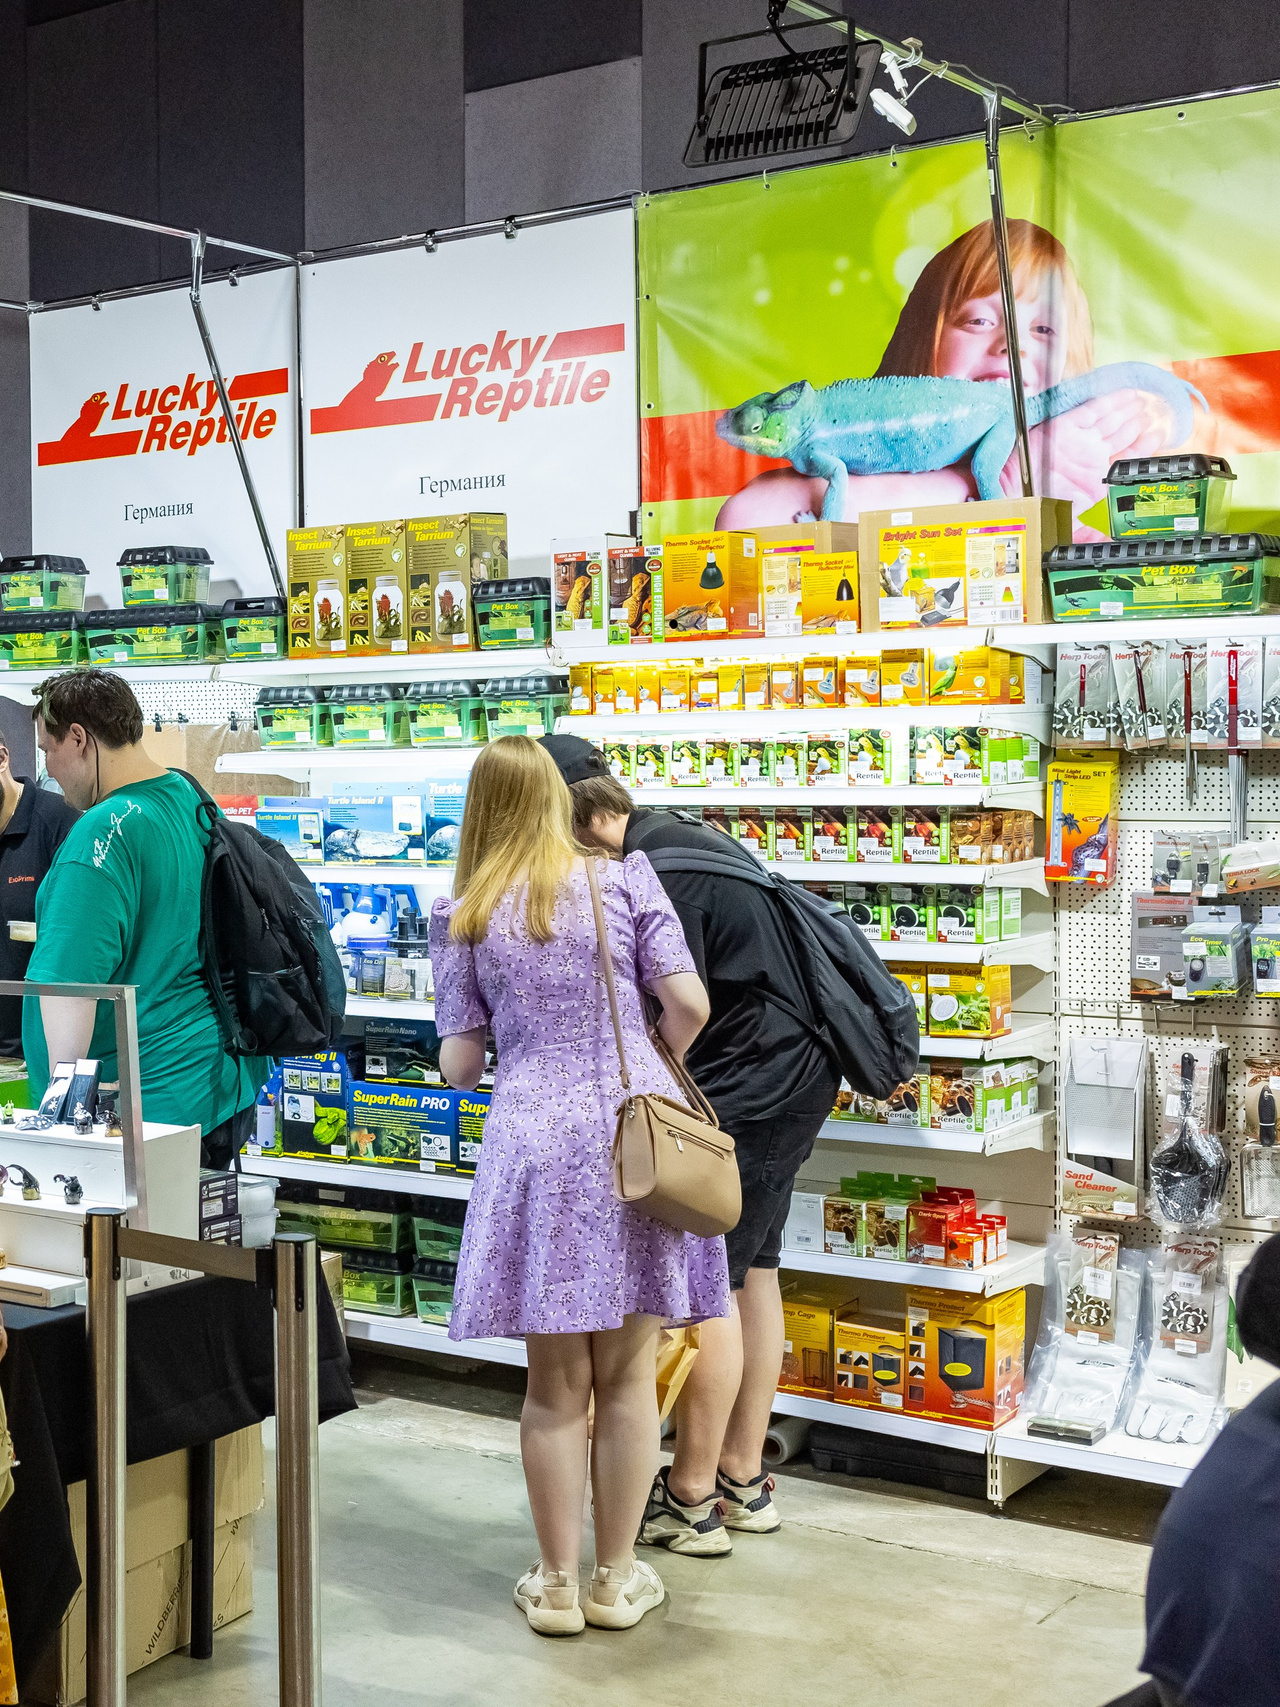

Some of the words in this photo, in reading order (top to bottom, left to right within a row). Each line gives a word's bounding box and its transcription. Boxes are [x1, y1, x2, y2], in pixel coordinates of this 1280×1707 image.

[402, 330, 548, 383] Lucky
[111, 373, 228, 420] Lucky
[440, 361, 611, 422] Reptile
[419, 474, 506, 498] Германия
[1139, 485, 1157, 494] Pet
[1158, 484, 1179, 493] Box
[123, 503, 194, 524] Германия
[408, 520, 440, 532] Insect
[288, 531, 318, 543] Insect
[347, 526, 377, 538] Insect
[414, 530, 455, 542] Tarrium
[883, 531, 918, 542] Bright
[920, 529, 941, 539] Sun
[944, 527, 963, 537] Set
[295, 540, 332, 551] Tarrium
[353, 536, 391, 548] Tarrium
[1141, 566, 1166, 577] Pet
[1169, 565, 1197, 575] Box
[654, 575, 662, 592] HIGH
[505, 603, 519, 611] Box
[654, 595, 663, 635] EFFICIENCY
[251, 618, 264, 626] Box
[16, 633, 28, 641] Pet
[29, 632, 44, 640] Box
[152, 627, 167, 635] Box
[1060, 653, 1081, 661] Herp
[1083, 652, 1106, 660] Tools
[429, 782, 463, 794] Turtle
[327, 796, 351, 805] Turtle
[351, 796, 377, 804] Island
[821, 847, 846, 855] Reptile
[866, 848, 892, 856] Reptile
[912, 848, 939, 856] Reptile
[899, 928, 926, 937] Reptile
[947, 929, 974, 937] Reptile
[365, 1025, 399, 1034] SuperRain
[399, 1026, 417, 1035] Nano
[353, 1090, 418, 1108] SuperRain
[420, 1096, 450, 1111] PRO
[884, 1111, 912, 1119] Reptile
[937, 1116, 966, 1124] Reptile
[1065, 1170, 1094, 1182] Sand
[1074, 1180, 1117, 1193] Cleaner
[323, 1211, 337, 1219] Pet
[339, 1211, 357, 1220] Box
[1095, 1242, 1115, 1251] Tools
[1193, 1248, 1216, 1257] Tools
[343, 1271, 360, 1280] Box
[910, 1298, 936, 1307] Thermo
[938, 1301, 965, 1312] Protect
[797, 1310, 816, 1321] Cage
[838, 1328, 861, 1338] Thermo
[863, 1332, 886, 1342] Protect
[145, 1569, 190, 1655] WILDBERRIES
